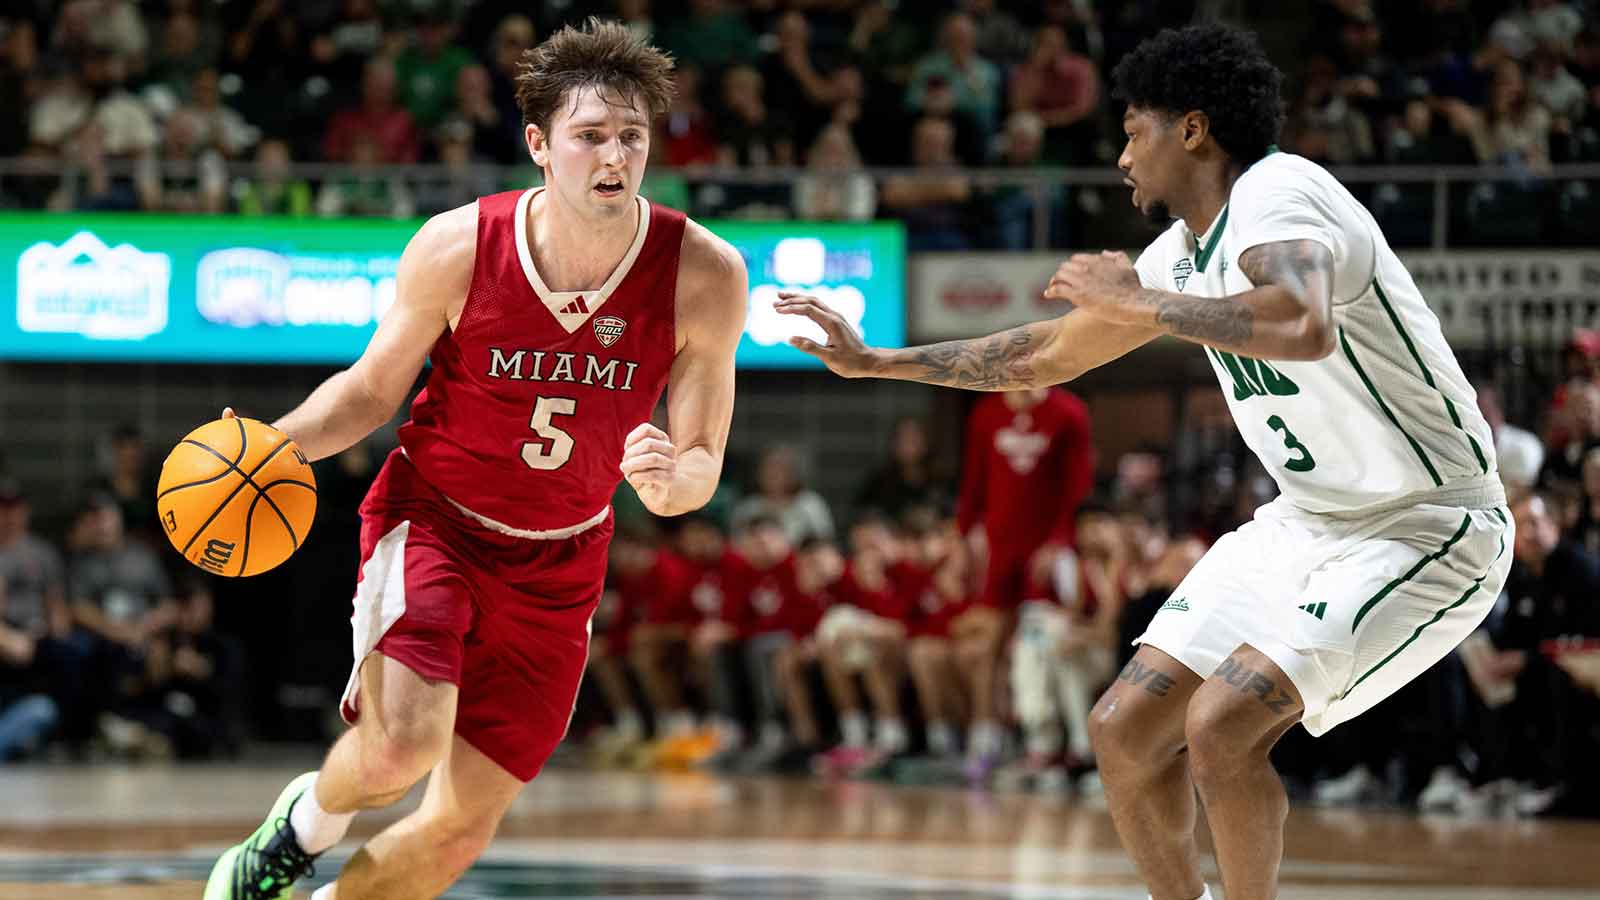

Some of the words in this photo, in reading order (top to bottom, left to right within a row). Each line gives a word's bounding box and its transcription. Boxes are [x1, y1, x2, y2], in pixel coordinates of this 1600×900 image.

[487, 347, 639, 391] MIAMI
[520, 394, 577, 471] 5
[1267, 415, 1316, 472] 3
